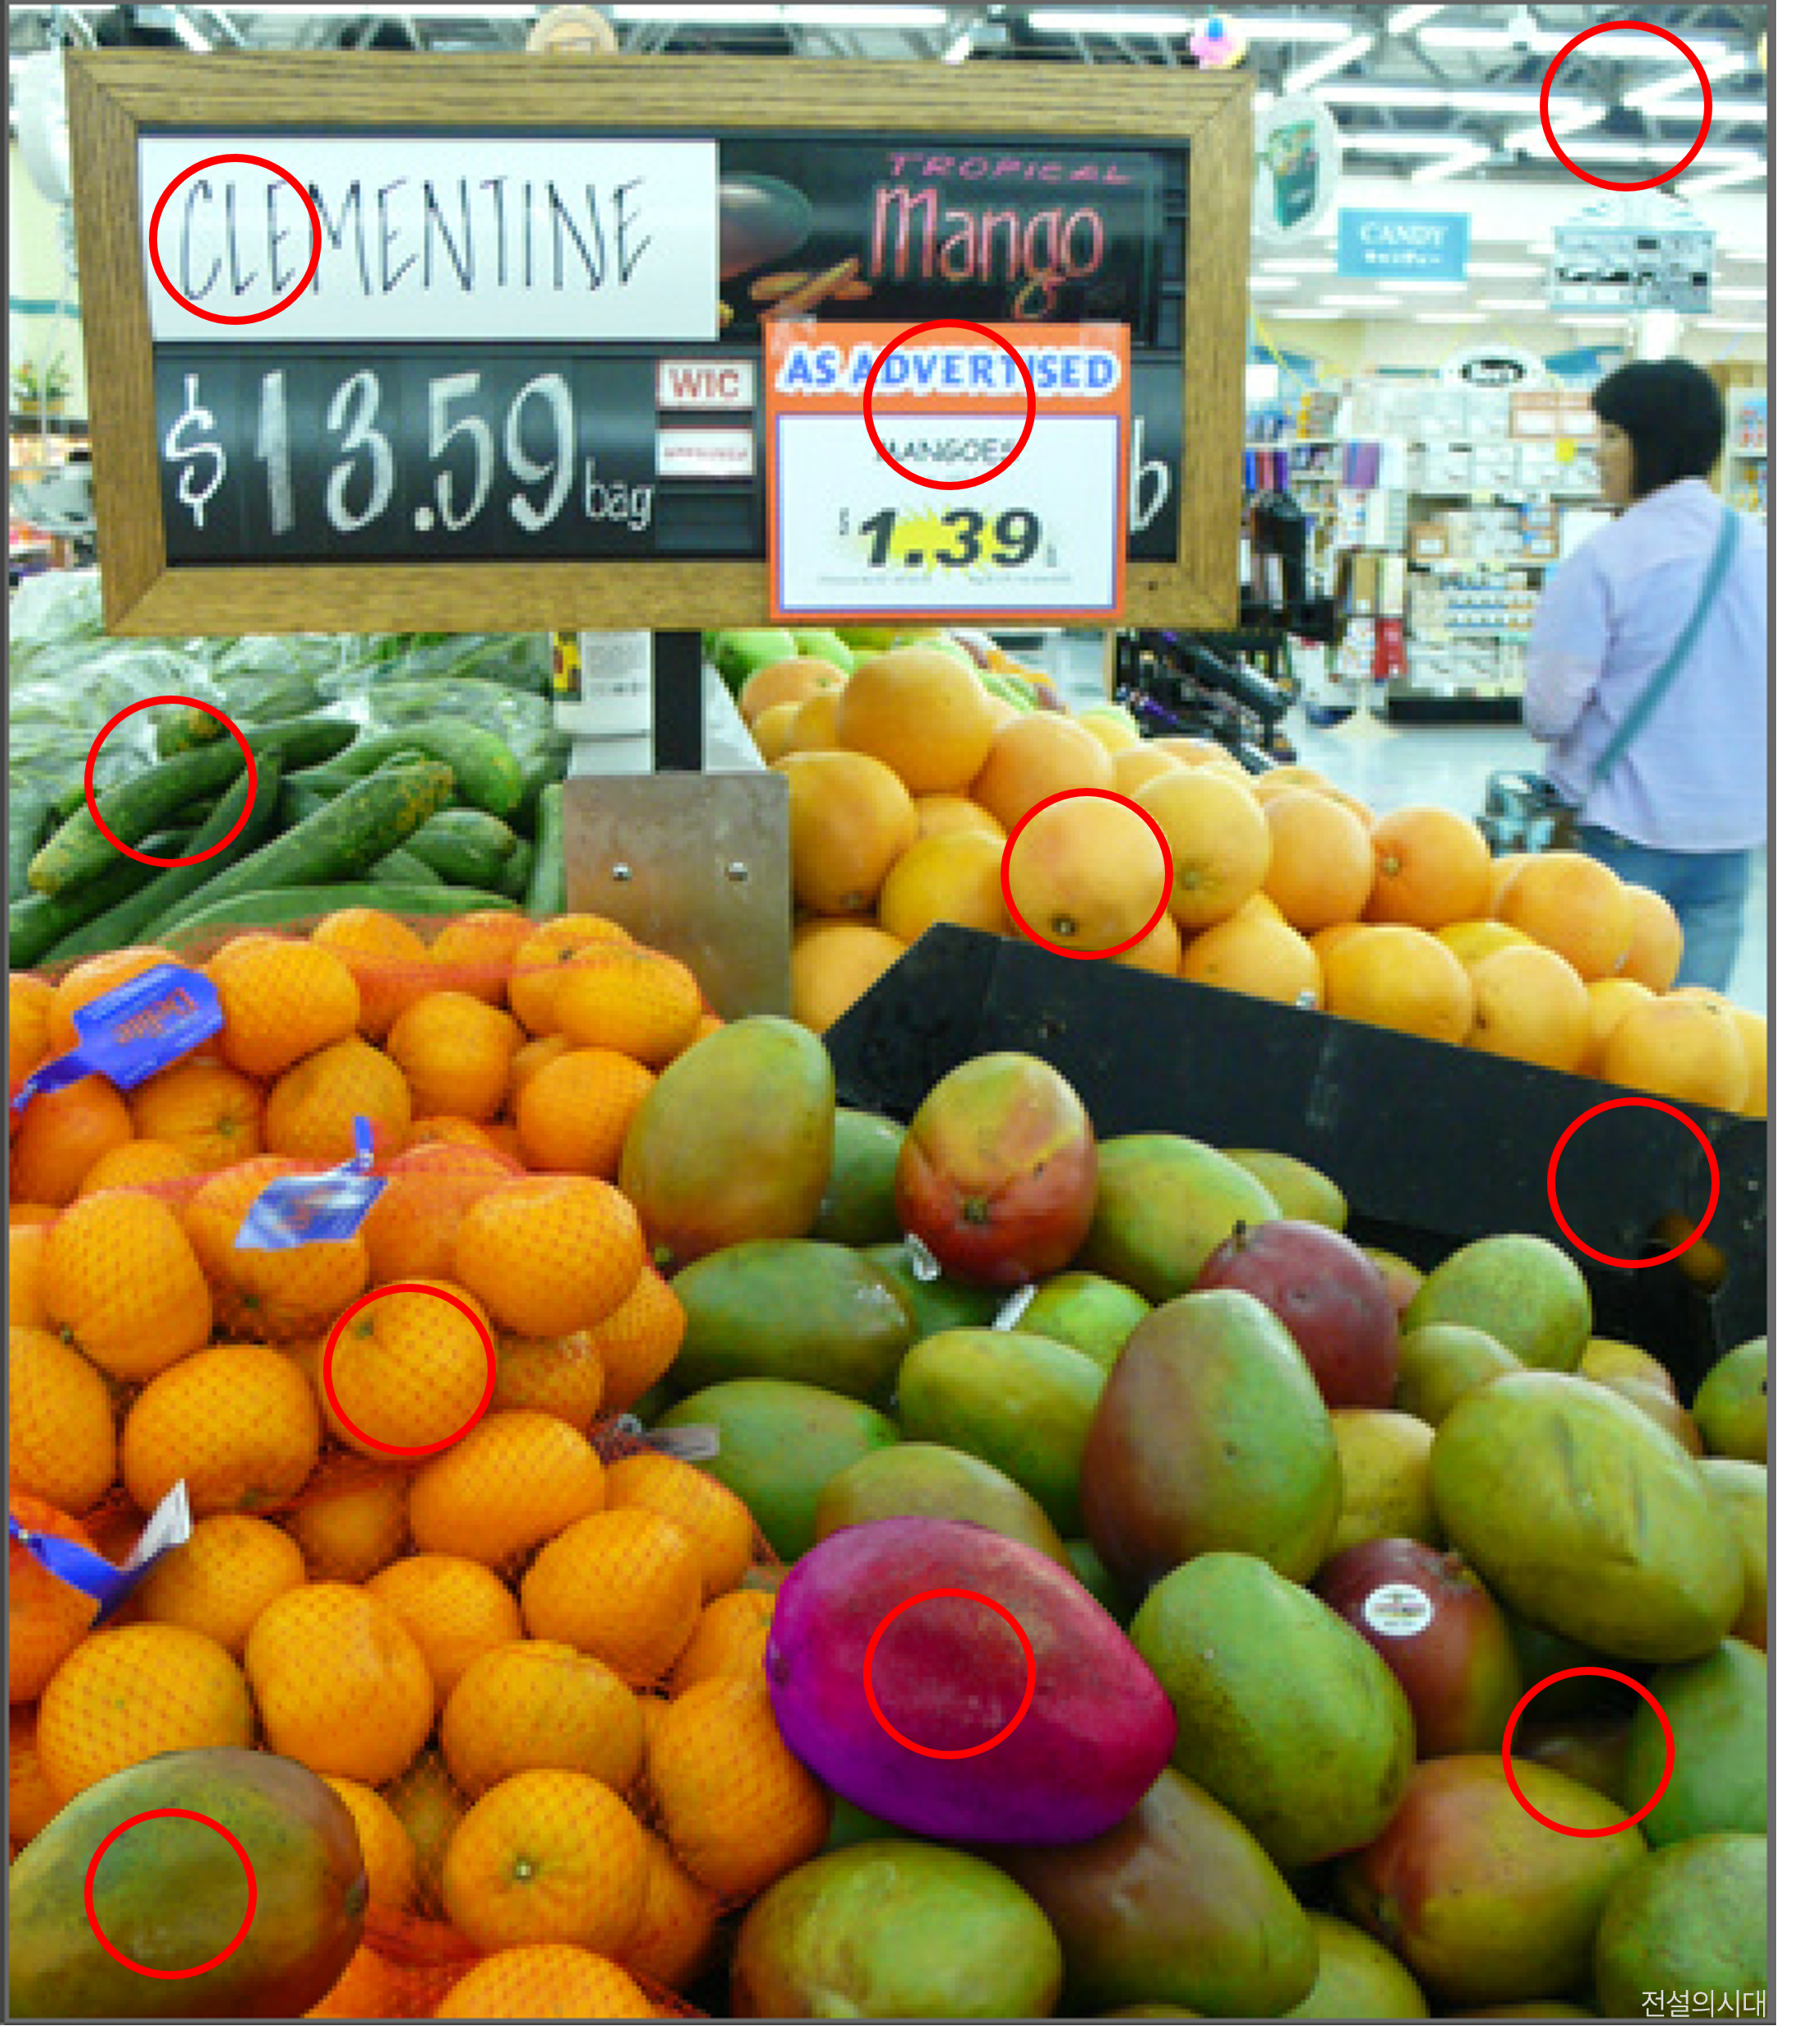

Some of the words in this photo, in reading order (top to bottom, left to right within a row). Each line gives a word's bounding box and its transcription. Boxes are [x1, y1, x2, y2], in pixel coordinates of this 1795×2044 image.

[885, 152, 1131, 185] TROPICAL
[180, 175, 651, 299] CLEMENTINE
[871, 183, 1104, 320] Mango
[1360, 220, 1449, 249] CANDY
[668, 368, 740, 398] WIC
[784, 350, 836, 387] AS
[165, 369, 575, 534] $13.59
[585, 456, 652, 531] bag
